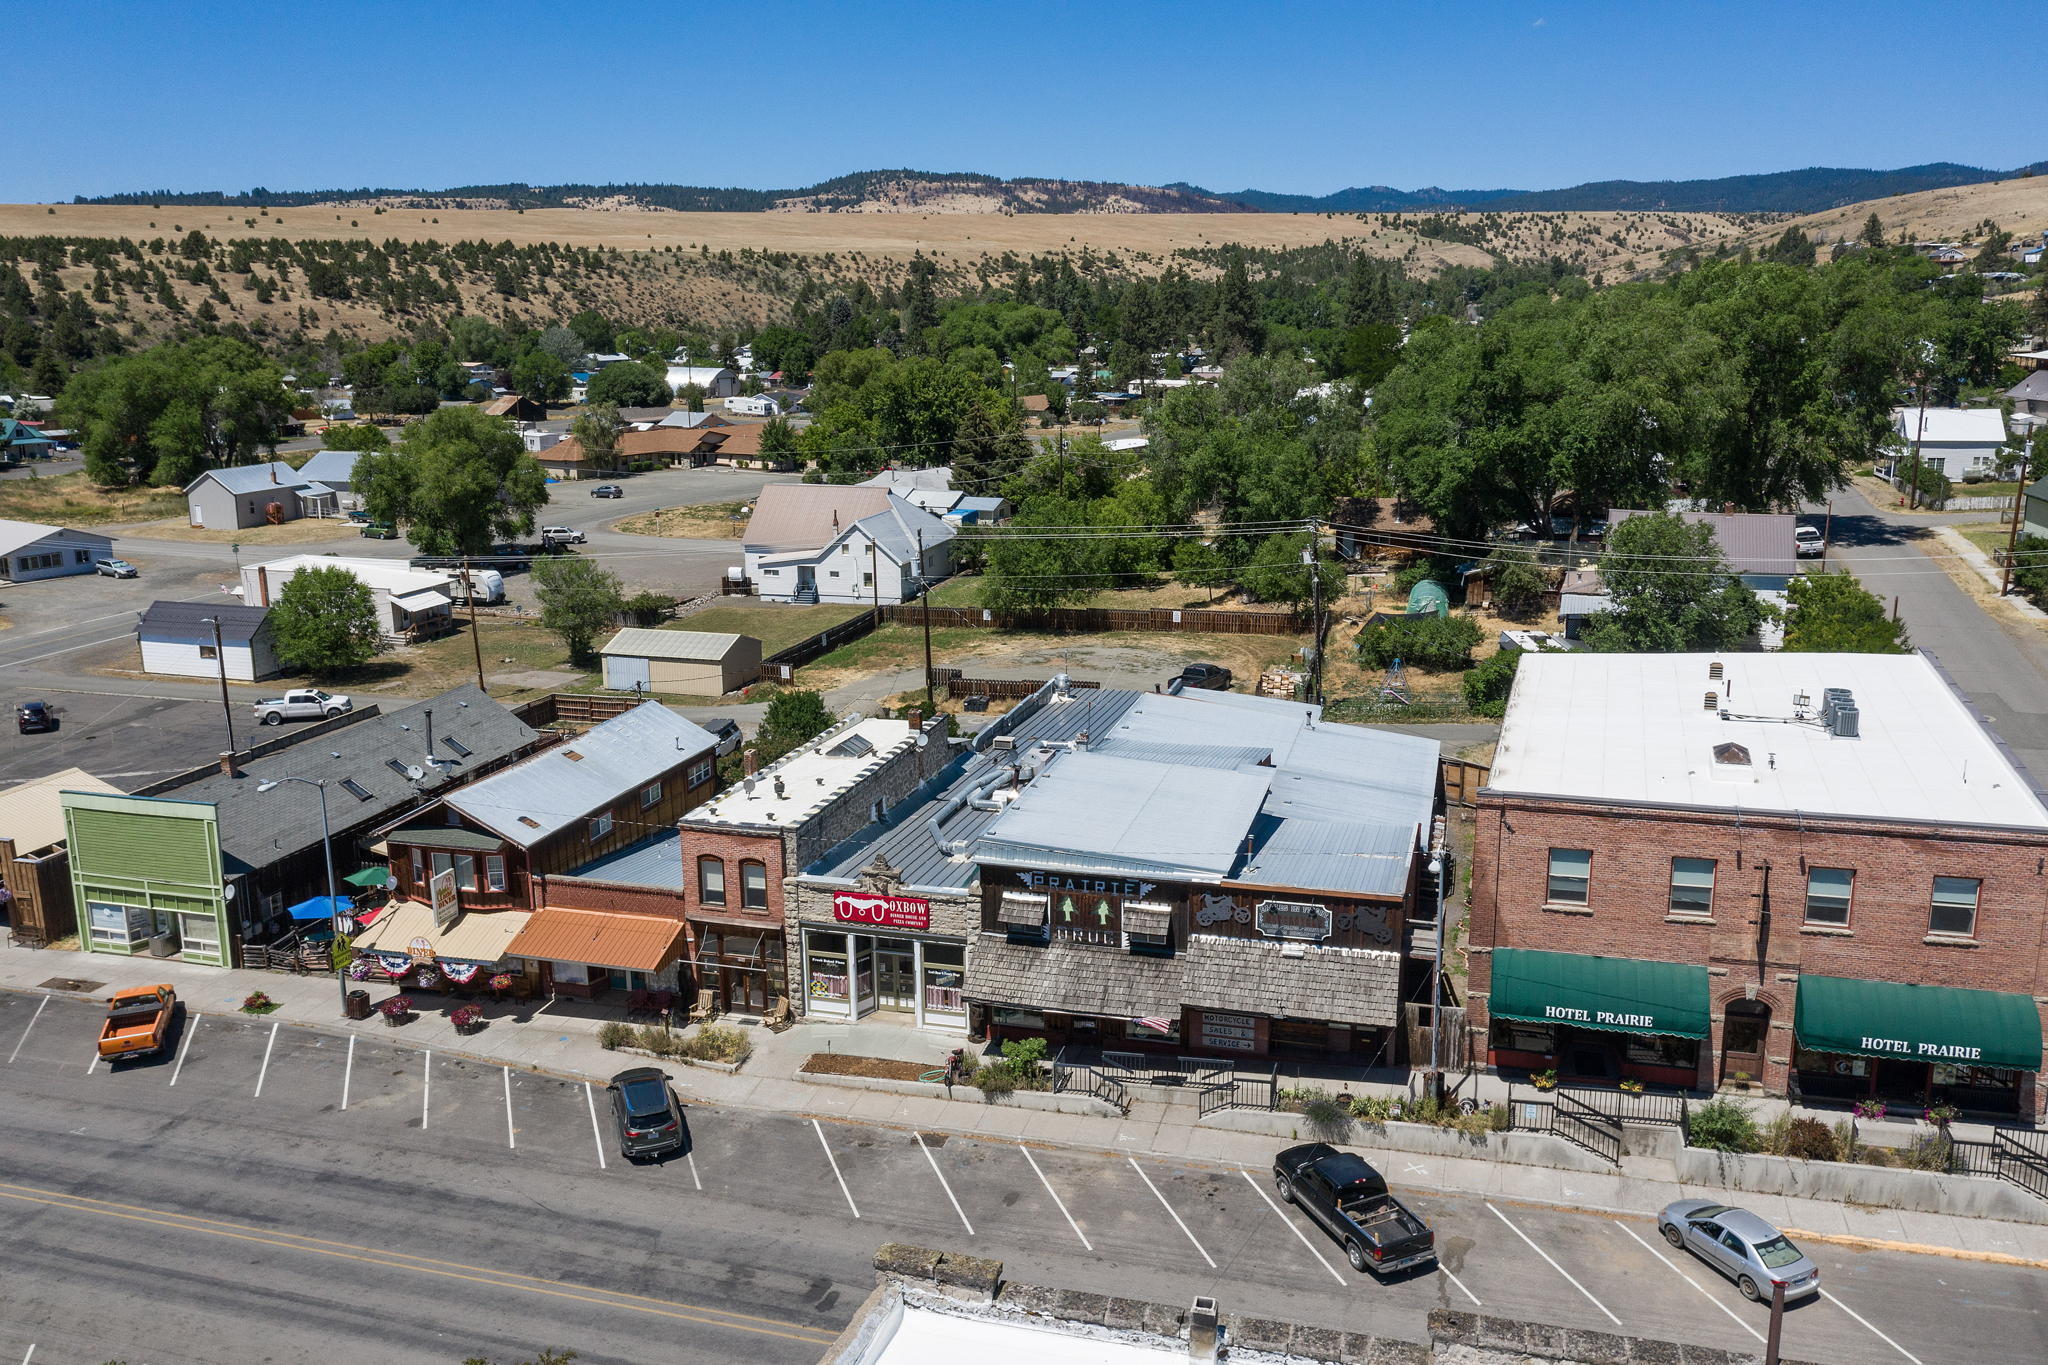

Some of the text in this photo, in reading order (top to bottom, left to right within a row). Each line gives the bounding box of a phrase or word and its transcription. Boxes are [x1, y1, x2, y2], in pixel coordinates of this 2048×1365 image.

[1032, 871, 1140, 897] PRAIRIE
[438, 895, 456, 908] DINER
[889, 900, 926, 914] OXBOW
[407, 946, 436, 957] DINER
[1204, 1014, 1249, 1025] MOTORCYCLE
[1545, 1005, 1654, 1027] HOTEL PRAIRIE
[1208, 1026, 1233, 1035] SALES
[1208, 1037, 1241, 1047] SERVICE
[1861, 1037, 1981, 1060] HOTEL PRAIRIE
